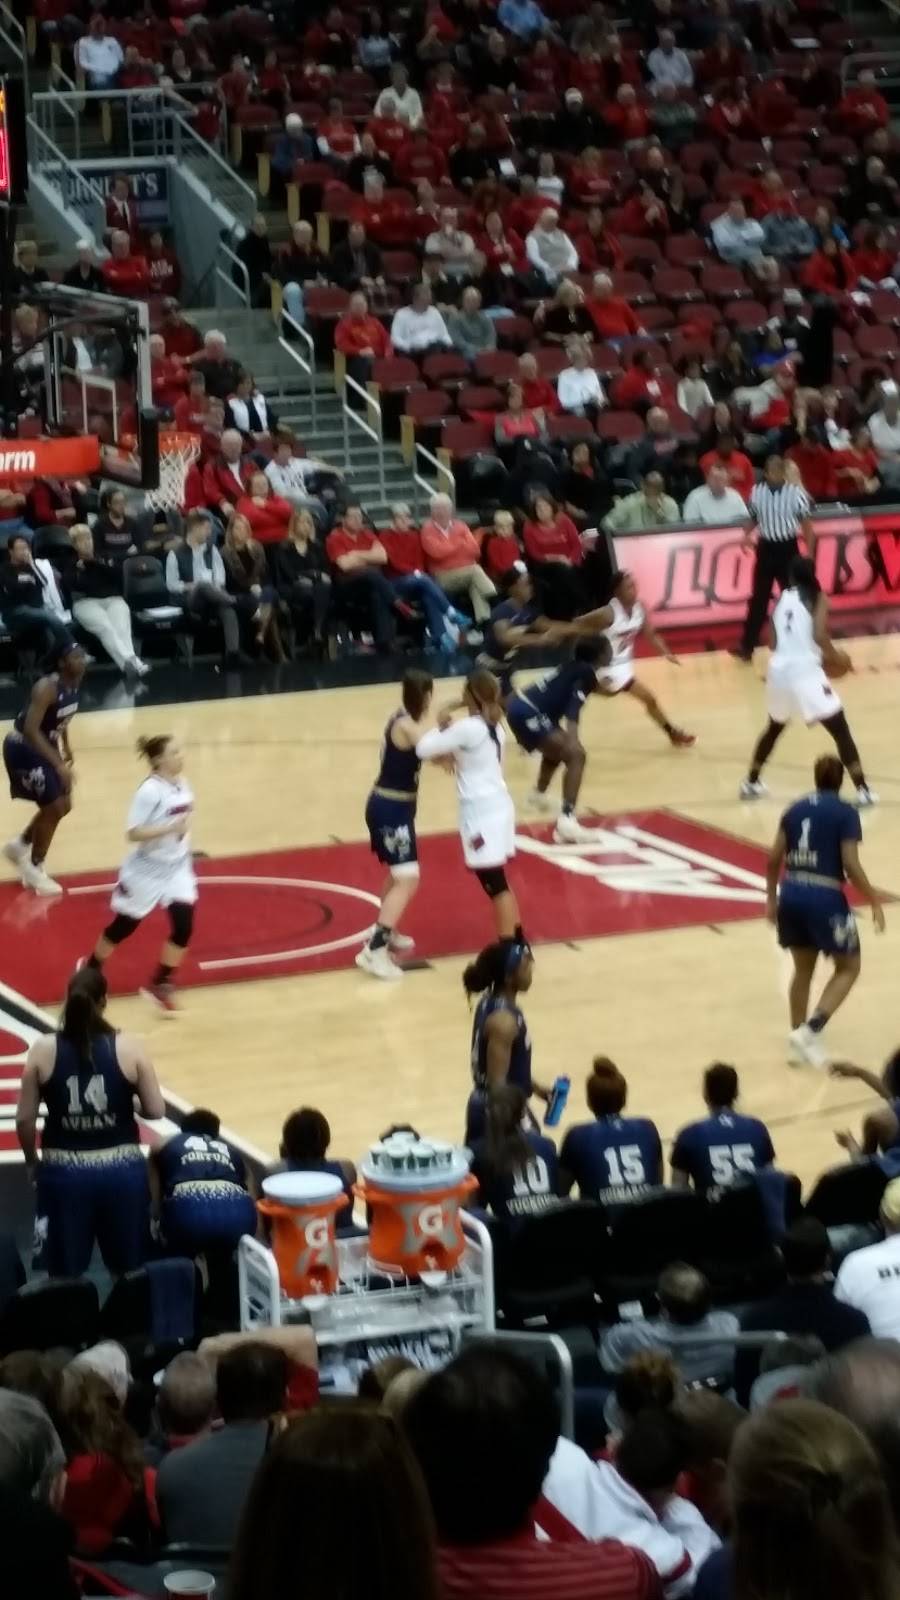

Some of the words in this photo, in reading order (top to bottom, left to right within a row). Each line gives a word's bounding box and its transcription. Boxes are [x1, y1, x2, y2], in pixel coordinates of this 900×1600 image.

[798, 817, 811, 852] 1
[66, 1074, 108, 1115] 14
[512, 1154, 550, 1196] 10
[604, 1144, 646, 1186] 15
[708, 1143, 756, 1186] 55
[304, 1218, 329, 1249] G
[417, 1204, 443, 1235] G
